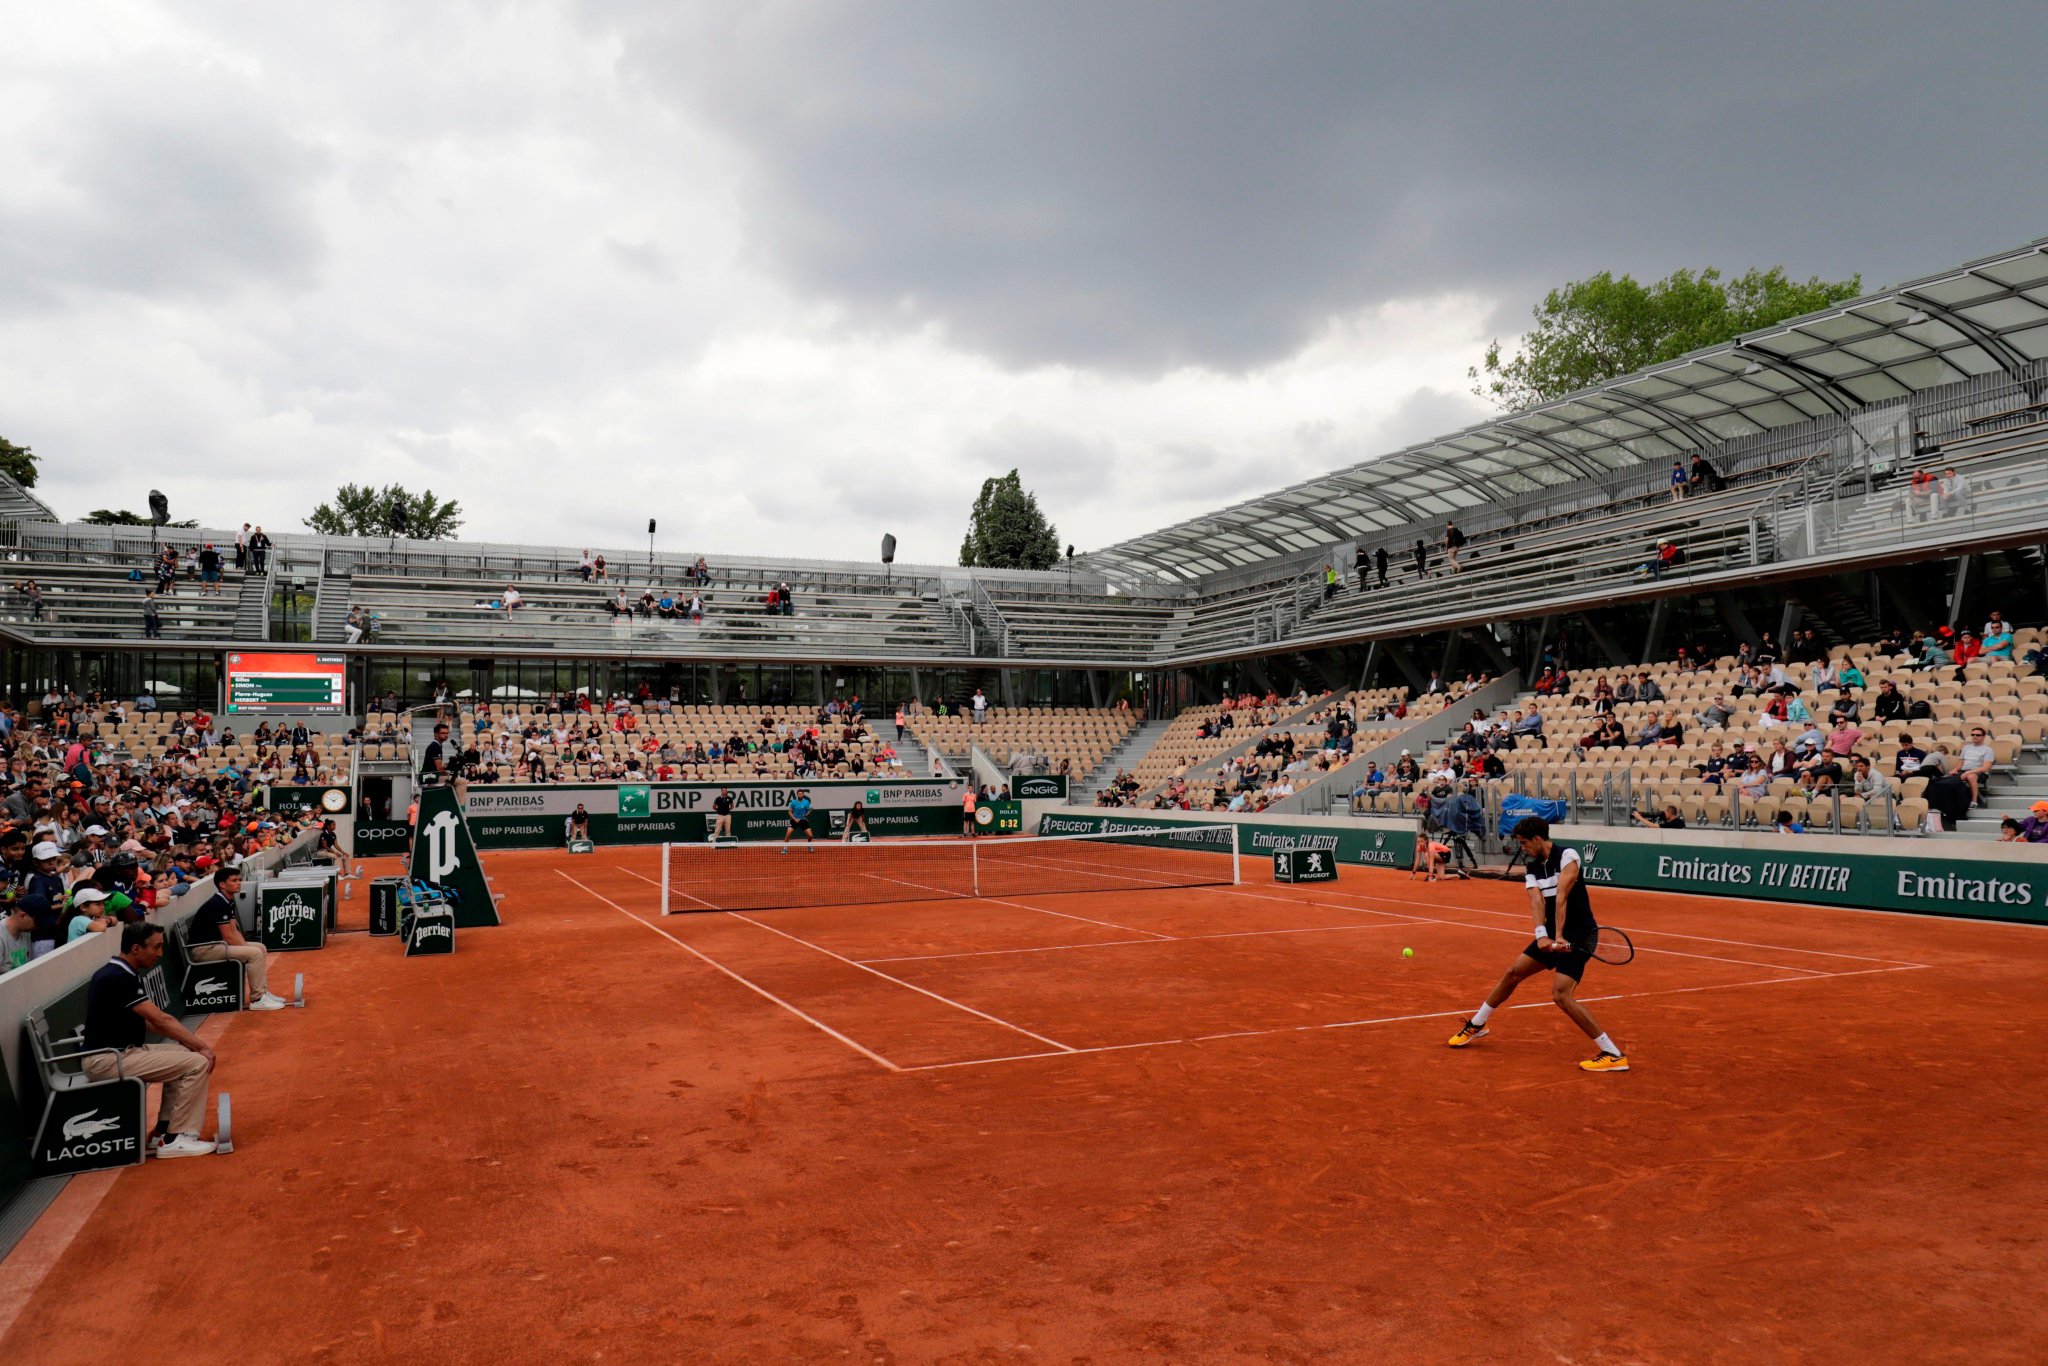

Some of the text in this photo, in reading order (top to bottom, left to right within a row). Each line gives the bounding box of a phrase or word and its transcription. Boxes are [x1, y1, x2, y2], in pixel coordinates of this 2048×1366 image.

[883, 788, 943, 799] BNP PARIBAS
[470, 795, 545, 807] BNP PARIBAS
[657, 791, 702, 810] BNP
[747, 820, 792, 828] BNP PARIB
[886, 815, 919, 823] PARIBAS
[482, 825, 545, 835] BNP PARIBAS
[617, 822, 676, 831] BNP PARIBAS
[1050, 820, 1094, 832] PEUGEOT
[357, 827, 407, 840] oppo
[1252, 831, 1296, 849] Emirates
[1360, 850, 1396, 863] ROLEX
[1582, 866, 1613, 881] LEX
[1657, 856, 1851, 892] Emirates FLY BETTER
[1897, 870, 2032, 905] Emirates
[268, 900, 316, 933] perrier
[415, 922, 451, 948] perrier
[185, 994, 237, 1007] LACOSTE
[46, 1136, 136, 1162] LACOSTE
